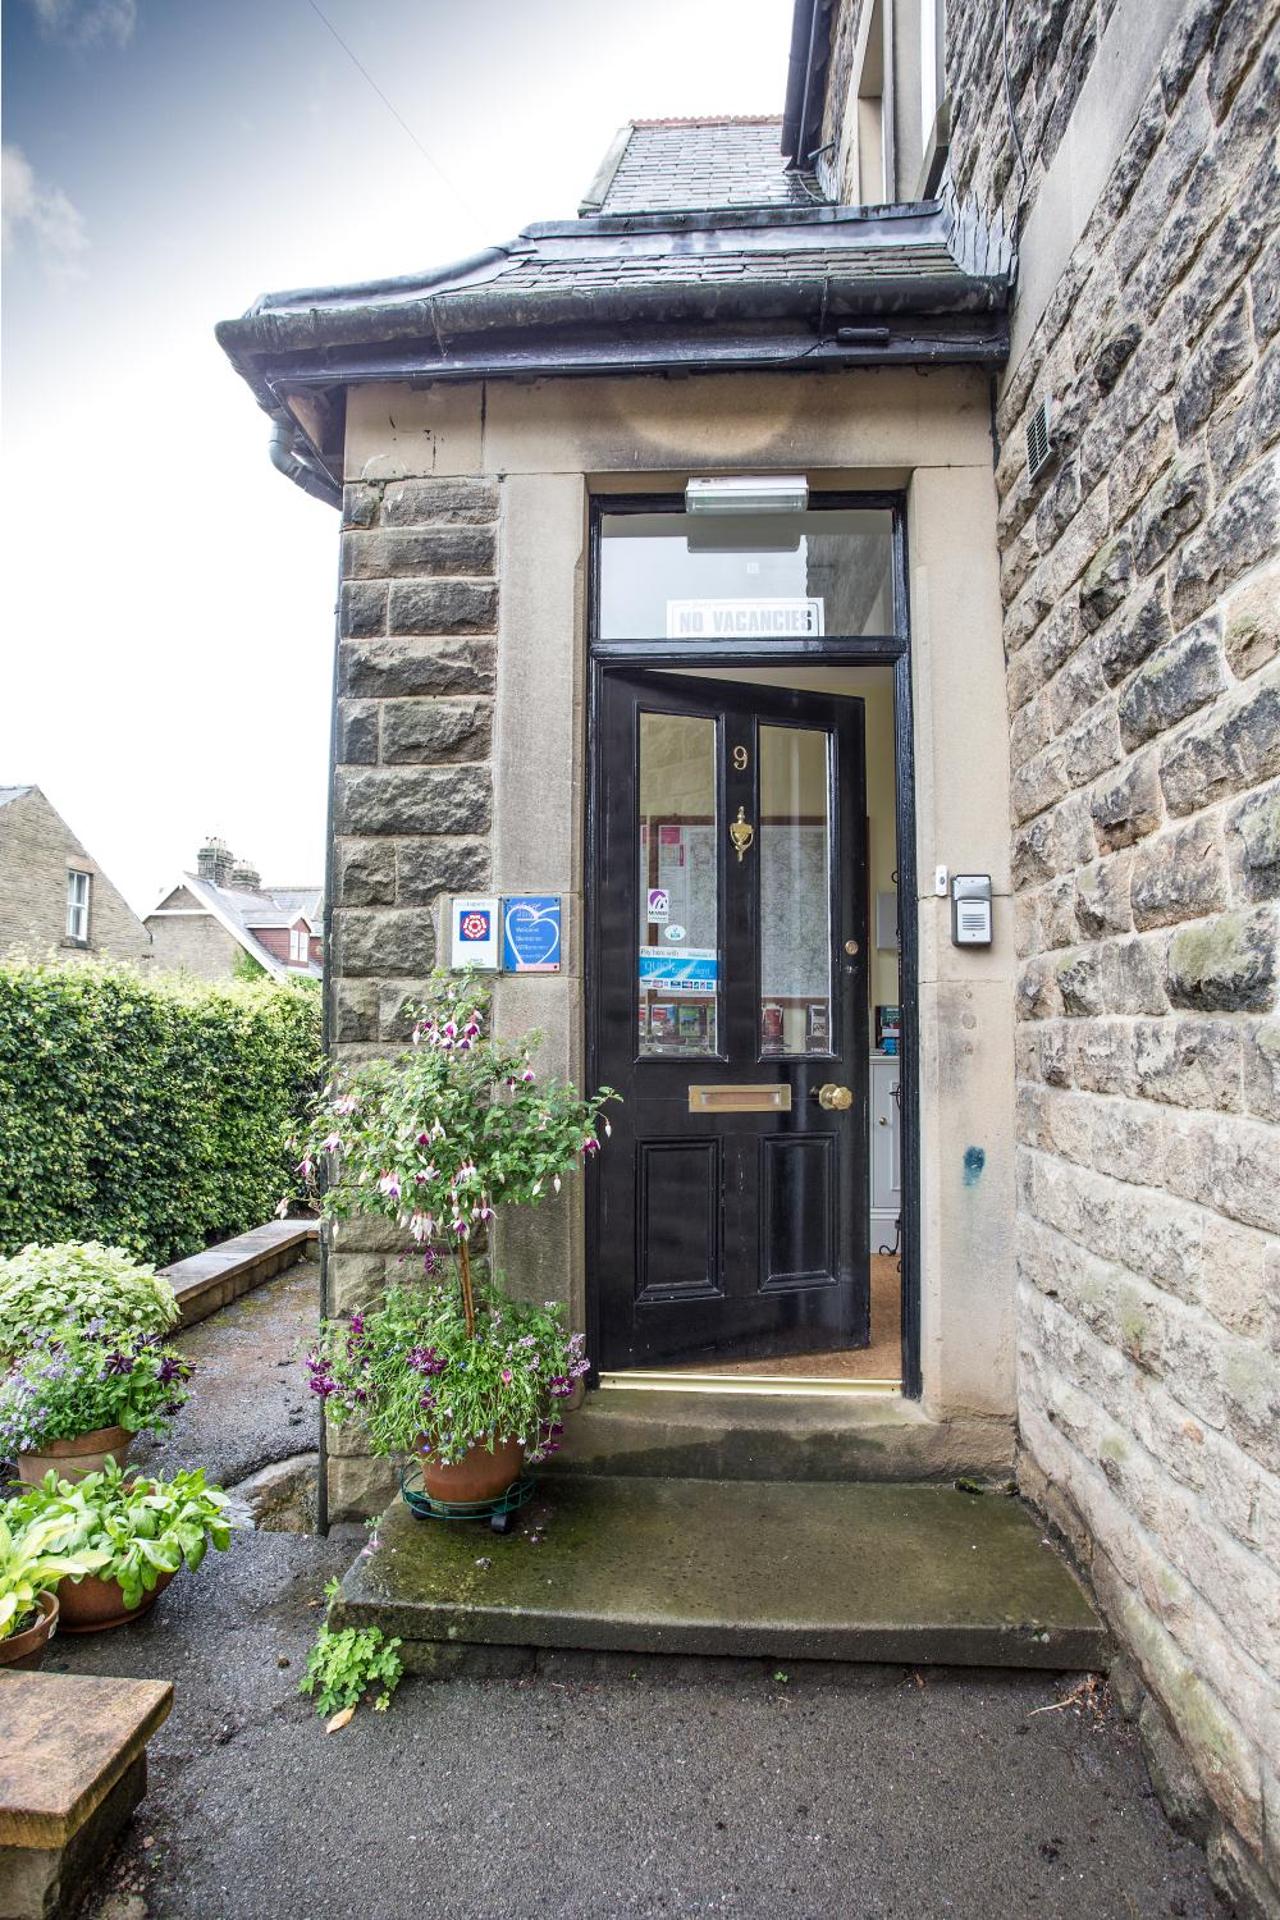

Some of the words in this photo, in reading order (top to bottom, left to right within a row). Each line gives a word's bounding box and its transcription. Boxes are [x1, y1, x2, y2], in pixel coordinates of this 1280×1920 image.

[680, 611, 704, 633] NO
[713, 609, 812, 632] VACANCIES
[733, 745, 748, 770] 9
